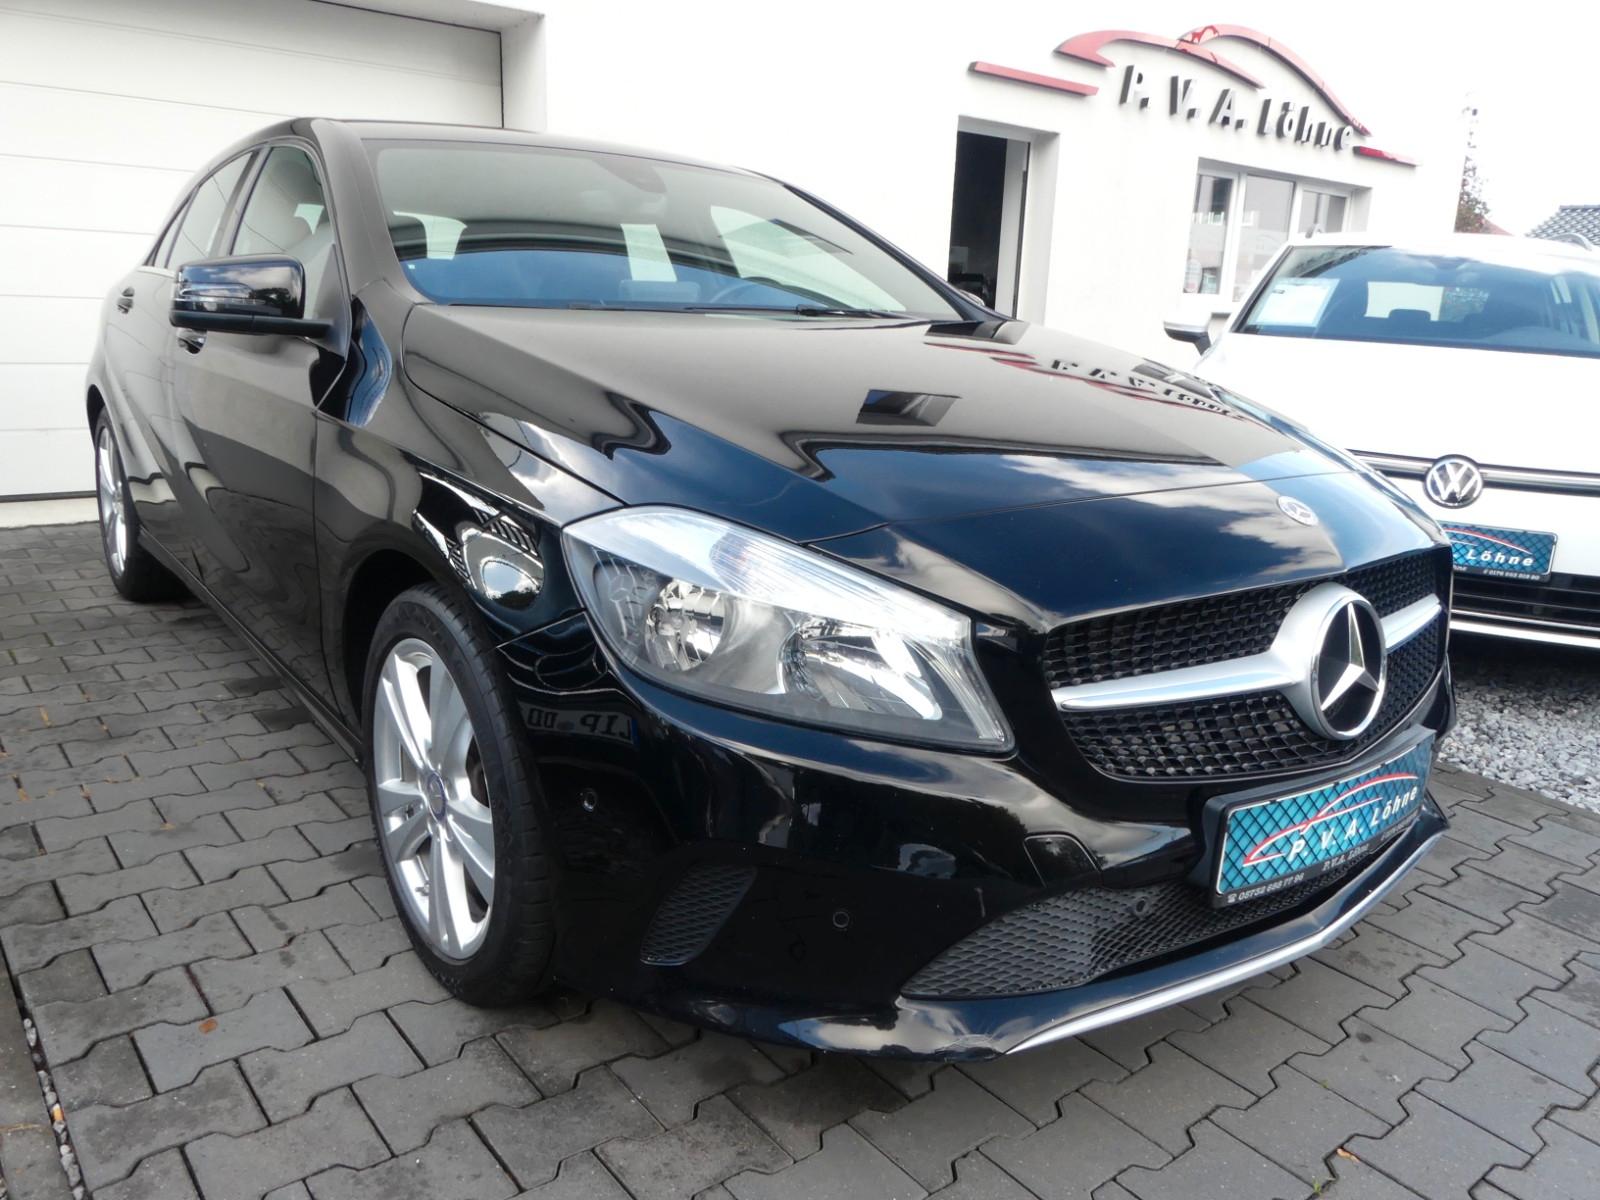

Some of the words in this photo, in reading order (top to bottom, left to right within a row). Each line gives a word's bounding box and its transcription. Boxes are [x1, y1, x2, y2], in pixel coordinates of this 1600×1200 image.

[1169, 75, 1200, 119] V.
[1208, 88, 1250, 130] A.
[1256, 97, 1354, 152] Löhne
[1465, 548, 1534, 566] Löhne
[1287, 838, 1309, 863] P.
[1320, 828, 1337, 849] V.
[1344, 821, 1364, 841] A.
[1371, 785, 1418, 826] Löhne
